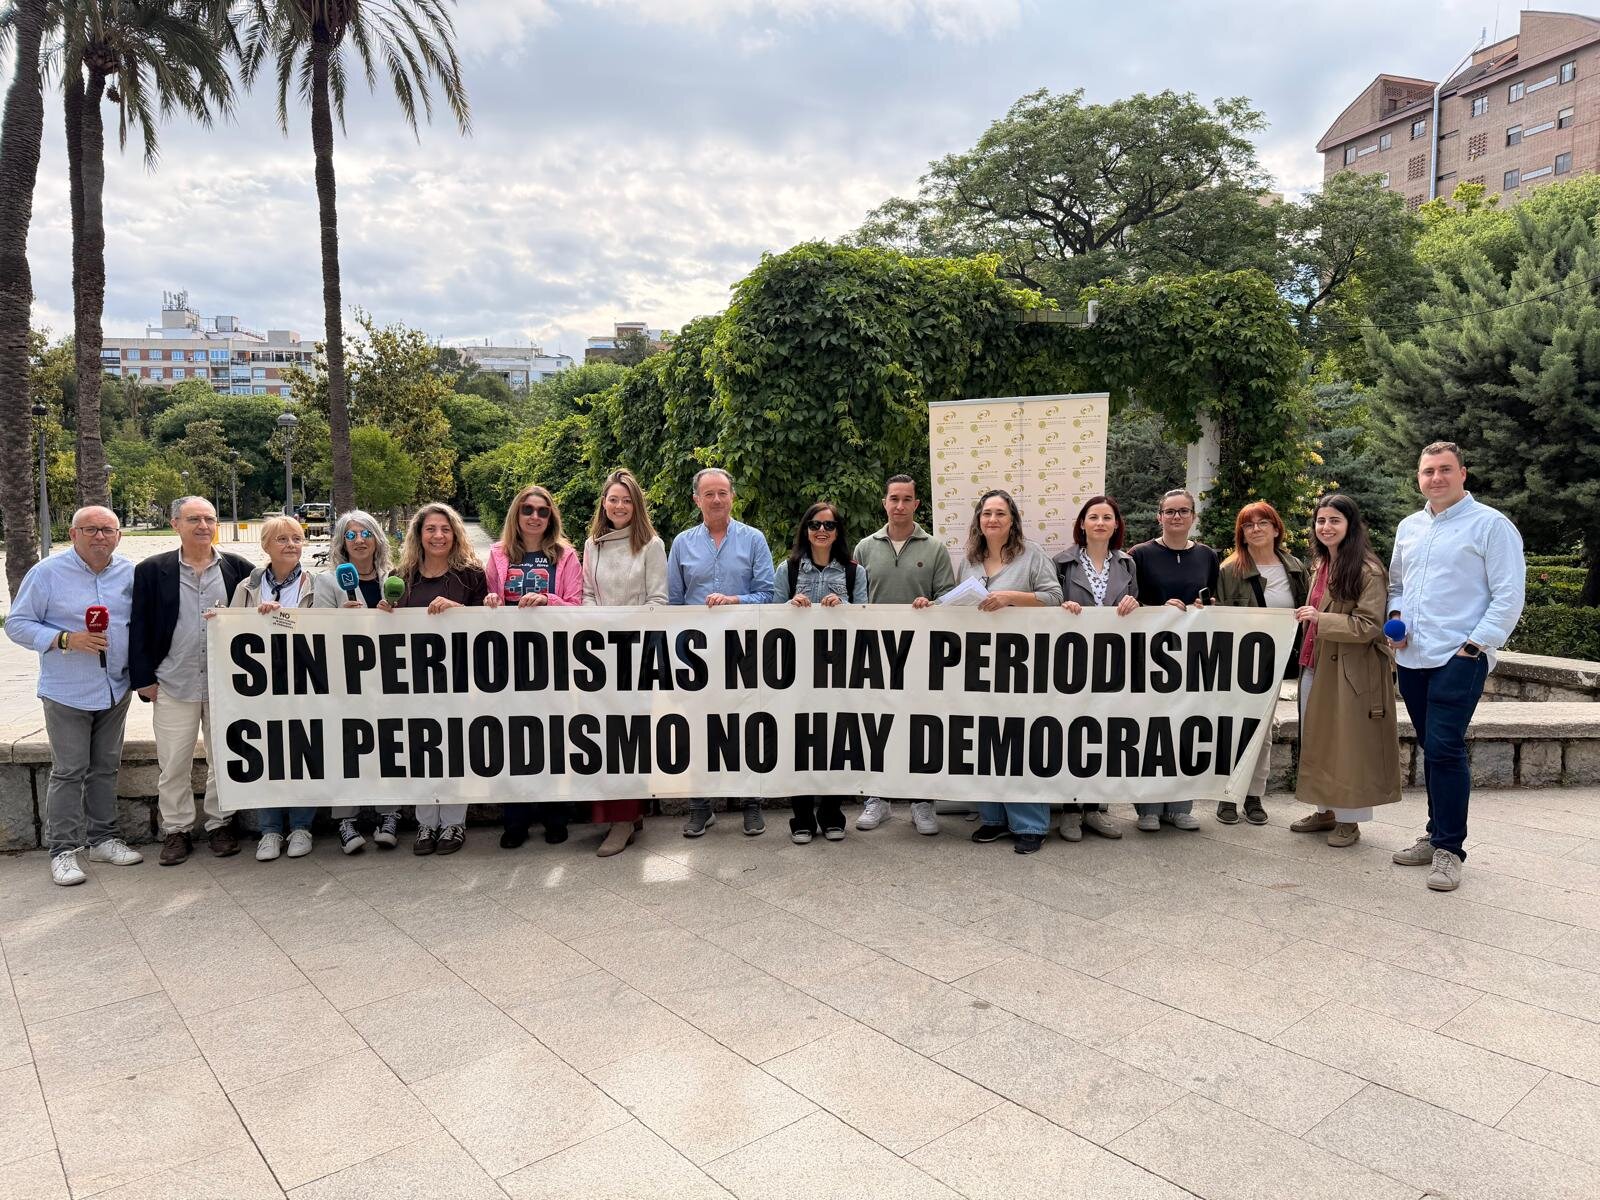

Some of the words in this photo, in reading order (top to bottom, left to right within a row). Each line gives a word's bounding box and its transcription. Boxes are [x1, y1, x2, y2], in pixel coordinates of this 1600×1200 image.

[231, 632, 329, 697] SIN
[343, 630, 708, 695] PERIODISTAS
[725, 628, 796, 690] NO
[814, 628, 915, 691] HAY
[929, 631, 1275, 694] PERIODISMO
[226, 719, 324, 784] SIN
[342, 713, 690, 779] PERIODISMO
[707, 712, 777, 775] NO
[795, 712, 894, 773] HAY
